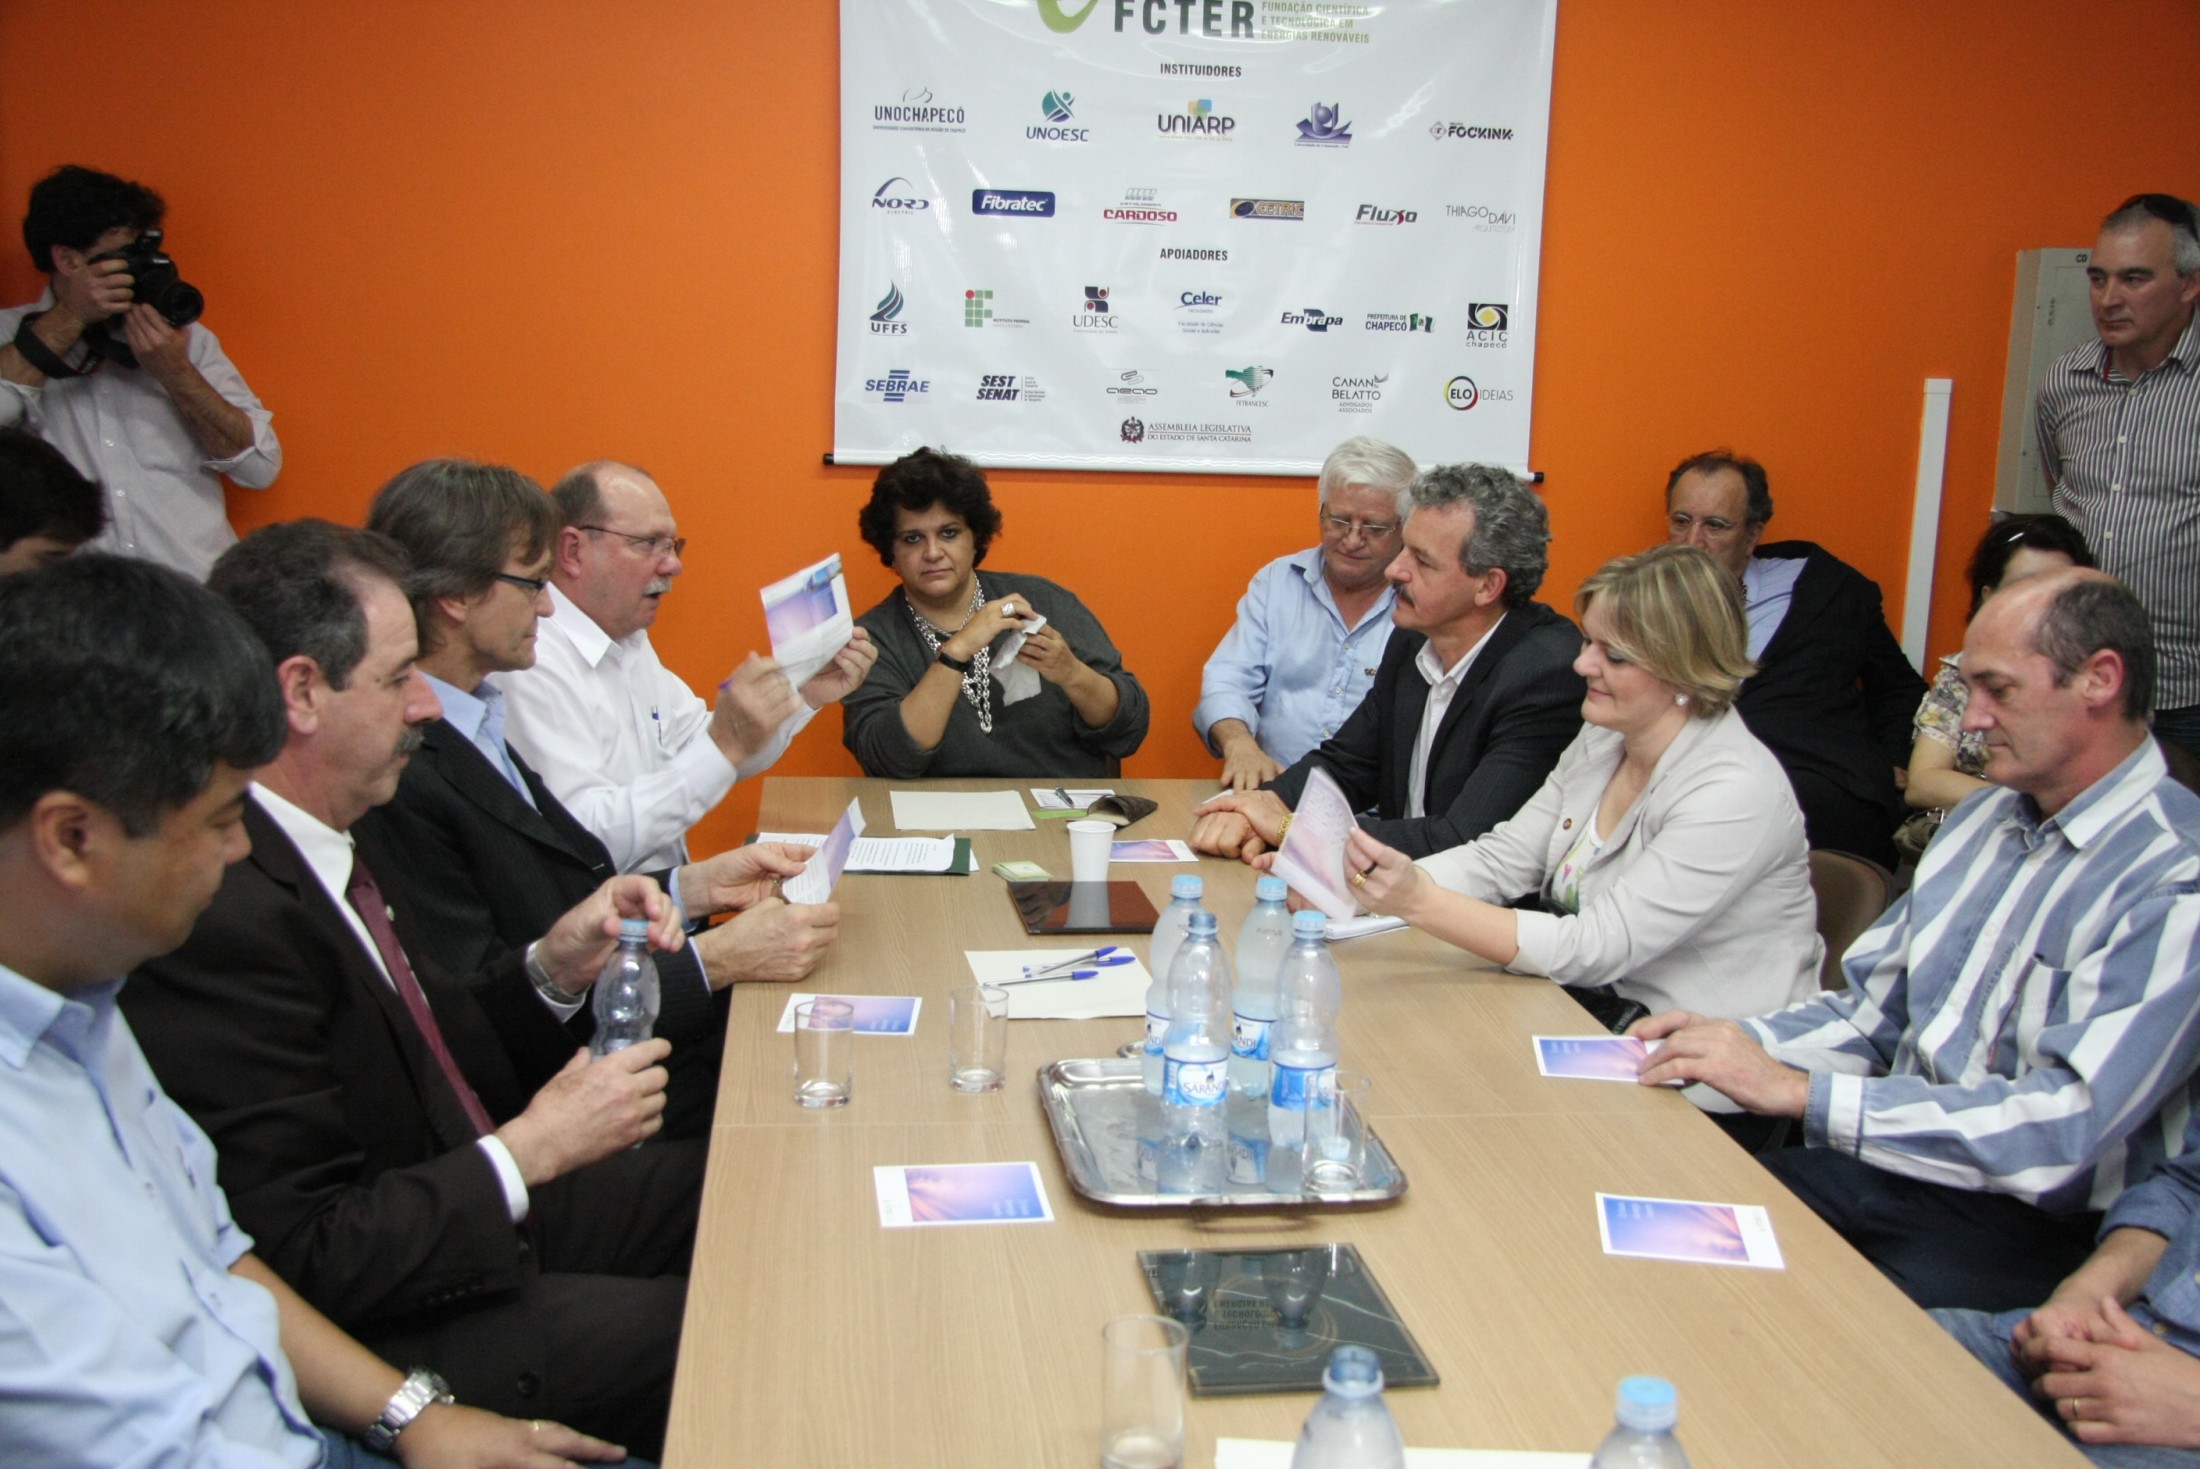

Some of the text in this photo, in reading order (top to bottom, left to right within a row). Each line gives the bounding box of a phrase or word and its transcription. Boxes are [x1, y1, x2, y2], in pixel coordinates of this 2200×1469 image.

[1261, 1, 1369, 15] FUNDAÇÃO CIENTÍFICA
[1114, 0, 1255, 38] FCTER
[1261, 16, 1353, 29] E TECNOLÓGICA EM
[1261, 30, 1370, 43] ENERGIAS RENOVÁVEIS
[1160, 63, 1242, 77] INSTITUIDORES
[874, 105, 965, 124] UNOCHAPECÓ
[1158, 114, 1235, 134] UNIARP
[1026, 126, 1090, 142] UNOESC
[1448, 125, 1514, 140] FOCKINK
[872, 197, 929, 210] NORD
[980, 194, 1045, 212] Fibratec
[1256, 201, 1304, 217] CETRIC
[1103, 208, 1178, 222] CARDOSO
[1356, 204, 1418, 225] Fluxo
[1446, 205, 1488, 218] THIAGO
[1159, 248, 1228, 261] APOIADORES
[1181, 290, 1223, 306] Celer
[1073, 314, 1119, 328] UDESC
[1280, 310, 1343, 328] Embrapa
[1366, 313, 1399, 321] PREFEITURA
[871, 322, 908, 334] UFFS
[1365, 319, 1407, 332] CHAPECÓ
[1466, 331, 1508, 342] ACIC
[1466, 340, 1507, 348] chapecó
[865, 379, 930, 393] SEBRAE
[981, 375, 1016, 387] SEST
[1332, 376, 1374, 387] CANAN
[976, 388, 1020, 401] SENAT
[1332, 389, 1381, 400] BELATTO
[1450, 388, 1473, 400] ELO
[1480, 389, 1514, 401] IDEIAS
[1149, 422, 1252, 433] ASSEMBLEIA LEGISLATIVA
[1218, 435, 1252, 443] CATARINA
